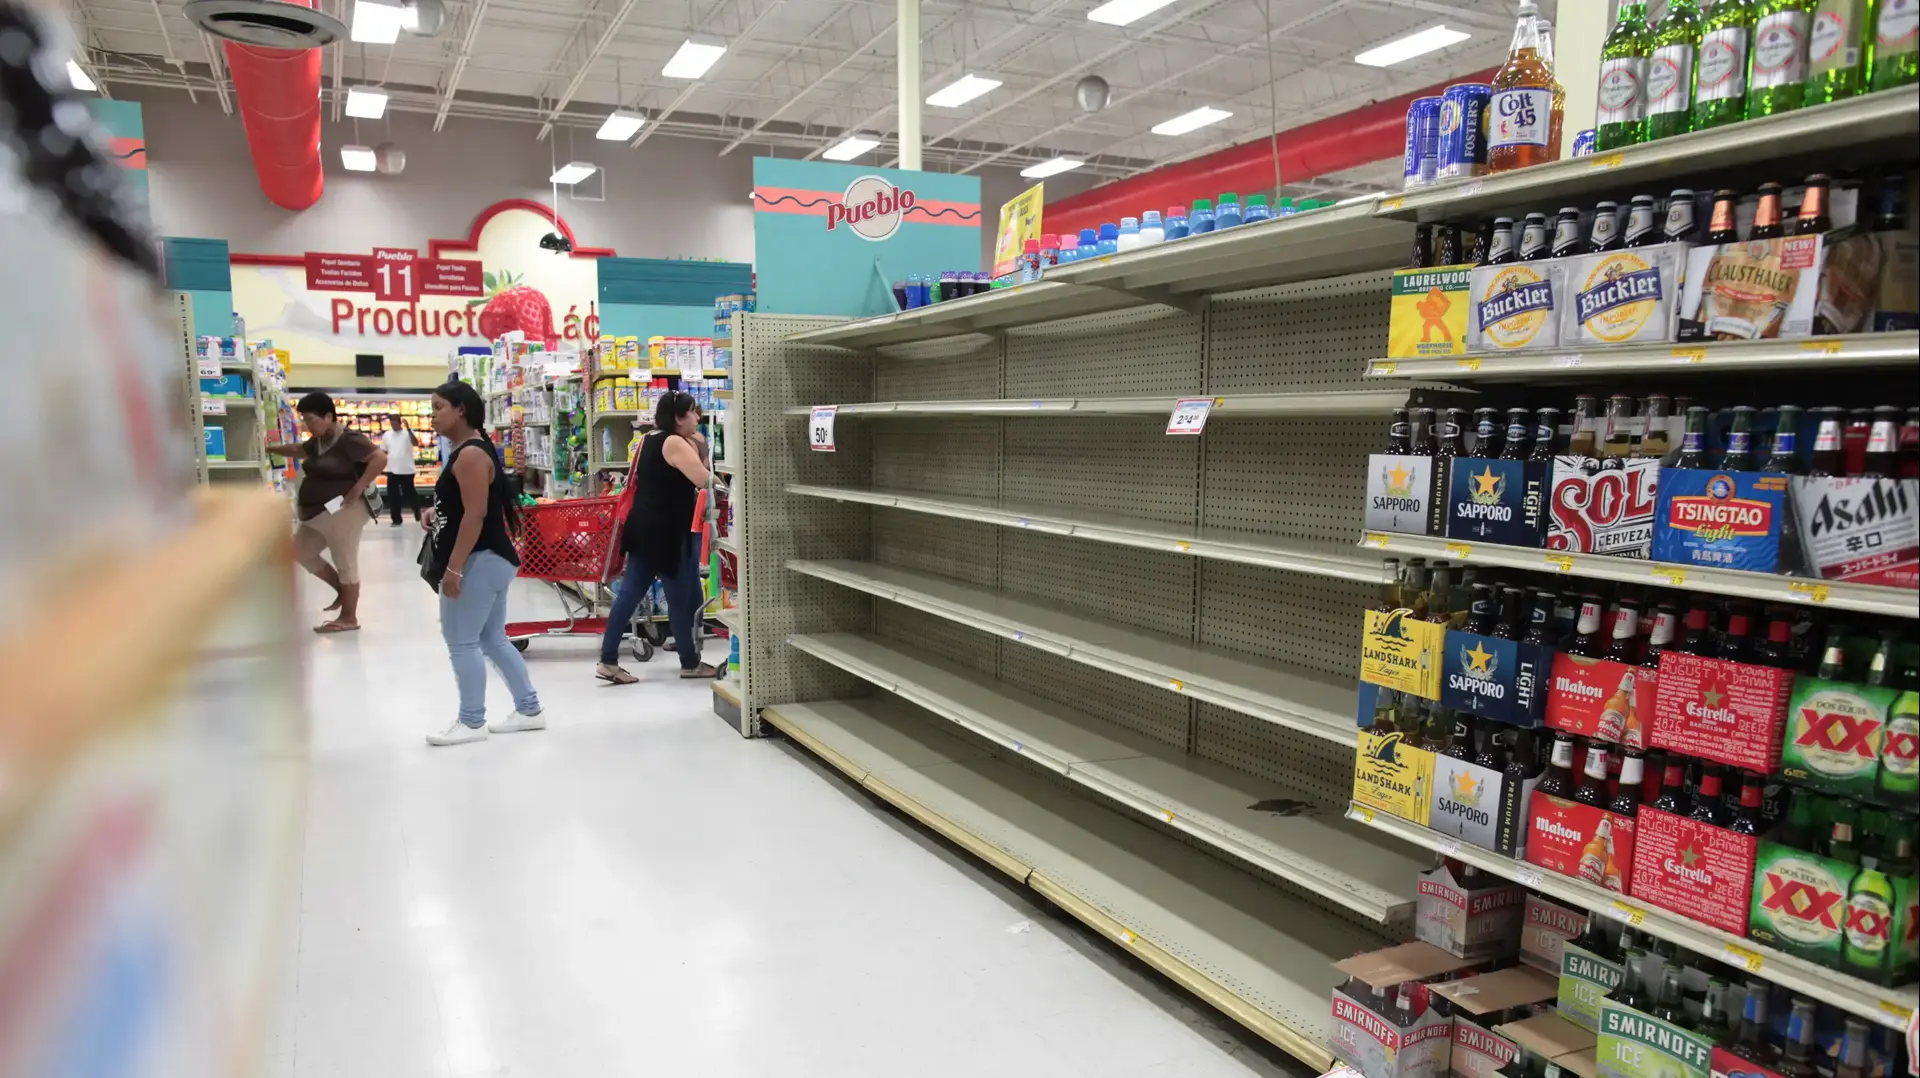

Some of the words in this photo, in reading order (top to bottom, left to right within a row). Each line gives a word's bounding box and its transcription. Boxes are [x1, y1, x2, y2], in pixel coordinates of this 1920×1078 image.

[1499, 92, 1534, 118] Colt
[1464, 99, 1478, 156] FOSTER'S
[1514, 109, 1536, 128] 45
[827, 186, 915, 230] Pueblo
[377, 250, 413, 261] Pueblo
[1784, 239, 1814, 250] NEW!
[377, 263, 412, 297] 11
[1403, 271, 1472, 288] LAURELWOOD
[1708, 260, 1793, 294] CLAUSTHALER
[1482, 288, 1550, 325] Buckler
[1582, 276, 1658, 318] Buckler
[1435, 462, 1444, 506] PREMIUM
[1373, 496, 1420, 512] SAPPORO
[1457, 503, 1512, 522] SAPPORO
[1525, 480, 1540, 528] LIGHT
[1676, 502, 1762, 526] TSINGTAO
[1811, 479, 1908, 538] Asahi
[1600, 529, 1652, 546] CERVEZA
[1694, 524, 1736, 543] Light
[1846, 532, 1882, 552] 辛口
[1364, 647, 1418, 670] LANDSHARK
[1378, 664, 1400, 676] Lager
[1662, 654, 1676, 664] 140
[1678, 656, 1701, 667] YEARS
[1740, 667, 1774, 679] YOUNG
[1661, 664, 1710, 679] AUGUST
[1449, 674, 1505, 699] SAPPORO
[1518, 662, 1533, 708] LIGHT
[1556, 676, 1602, 698] Mahou
[1686, 700, 1735, 724] Estrella
[1816, 702, 1836, 712] DOS
[1838, 704, 1867, 715] EQUIS
[1690, 722, 1728, 734] BARCELONA
[1738, 720, 1768, 734] BEER
[1796, 708, 1880, 758] XX
[1356, 768, 1411, 796] LANDSHARK
[1370, 787, 1392, 800] Lager
[1438, 798, 1488, 826] SAPPORO
[1505, 782, 1514, 826] PREMIUM
[1502, 827, 1510, 850] BEER
[1536, 816, 1582, 842] Mahou
[1638, 816, 1686, 837] AUGUST
[1694, 830, 1704, 843] K
[1640, 808, 1654, 819] 140
[1656, 812, 1678, 826] YEARS
[1700, 824, 1714, 834] THE
[1716, 830, 1748, 846] YOUNG
[1664, 858, 1712, 884] Estrella
[1780, 868, 1798, 878] DOS
[1800, 873, 1829, 888] EQUIS
[1422, 882, 1464, 906] SMIRNOFF
[1668, 878, 1704, 894] BARCELONA
[1714, 882, 1743, 899] BEER
[1432, 902, 1450, 917] ICE
[1760, 872, 1844, 932] XX
[1846, 904, 1892, 940] XX
[1536, 930, 1556, 952] ICE
[1574, 984, 1596, 1006] ICE
[1336, 1001, 1394, 1046] SMIRNOFF
[1340, 1024, 1356, 1046] ICE
[1404, 1025, 1448, 1046] SMIRNOFF
[1609, 1012, 1708, 1066] SMIRNOFF
[1465, 1053, 1484, 1071] ICE
[1616, 1042, 1644, 1068] ICE
